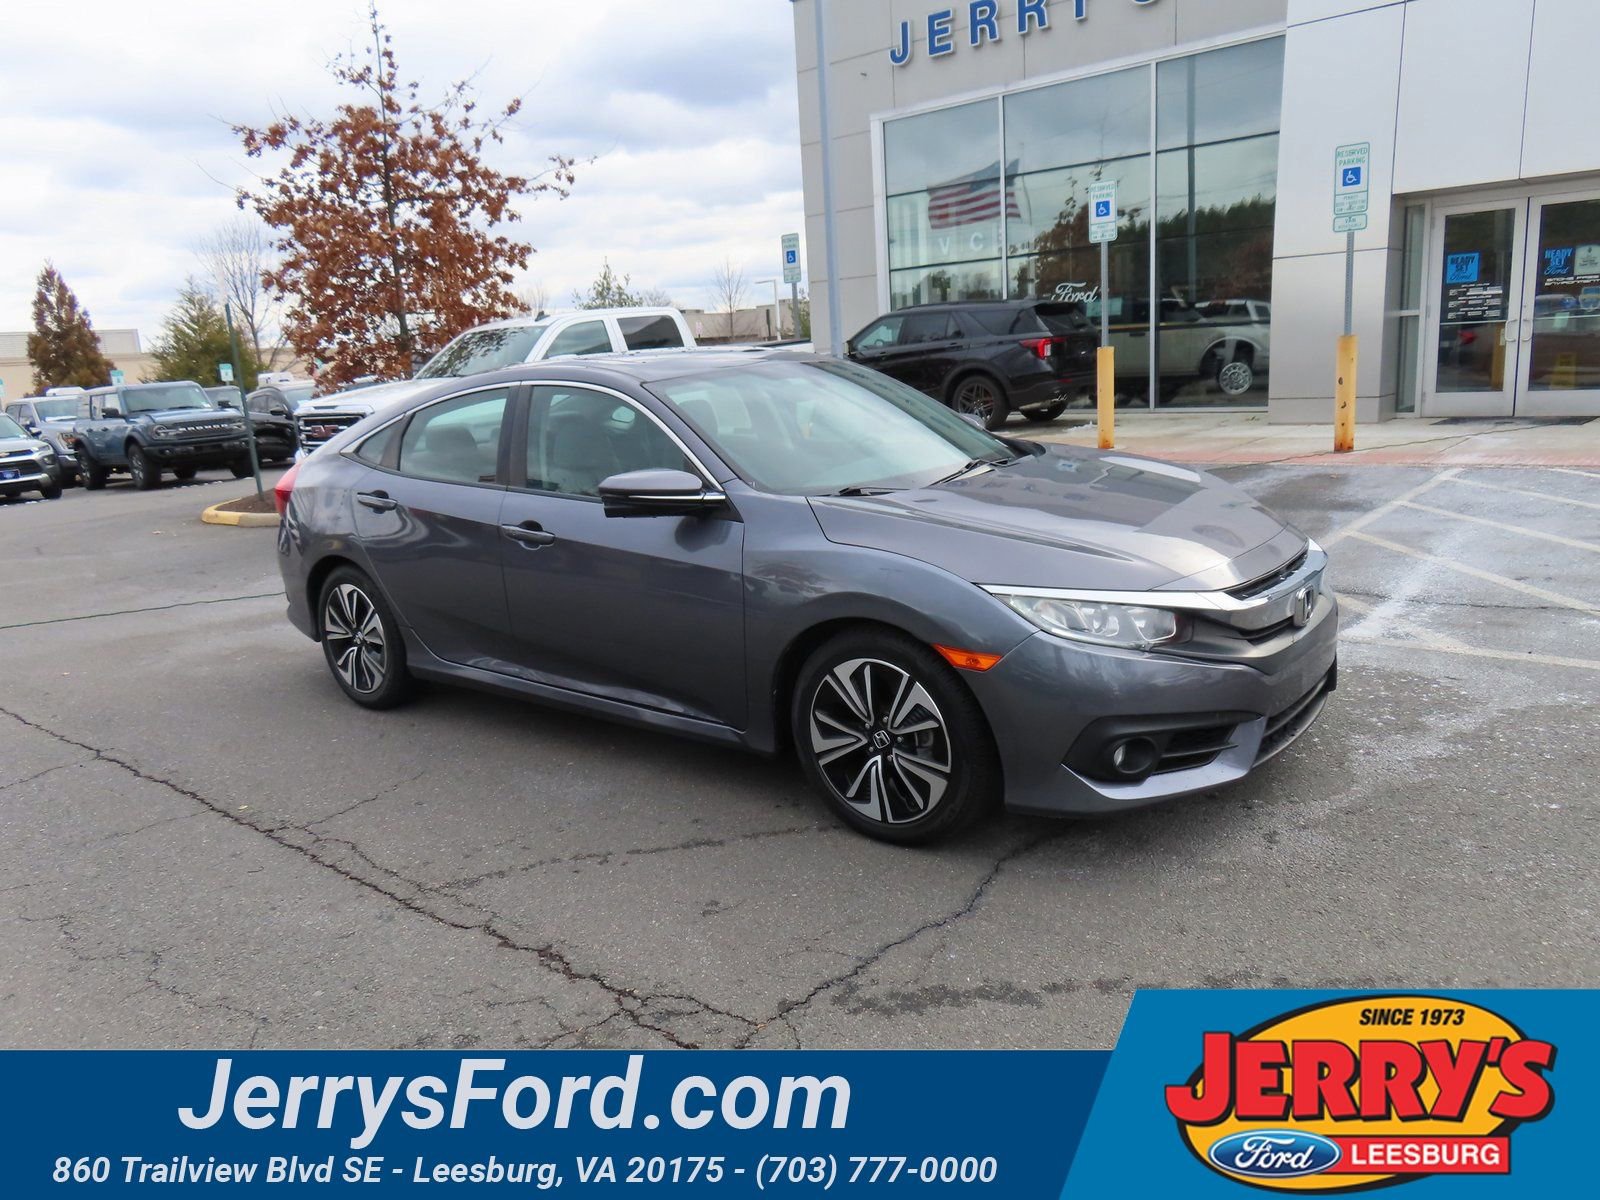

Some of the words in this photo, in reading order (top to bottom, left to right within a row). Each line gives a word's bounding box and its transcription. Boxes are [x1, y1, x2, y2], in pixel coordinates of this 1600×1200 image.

[1337, 148, 1368, 157] RESERVED
[1339, 157, 1366, 166] PARKING
[1051, 281, 1099, 302] Ford
